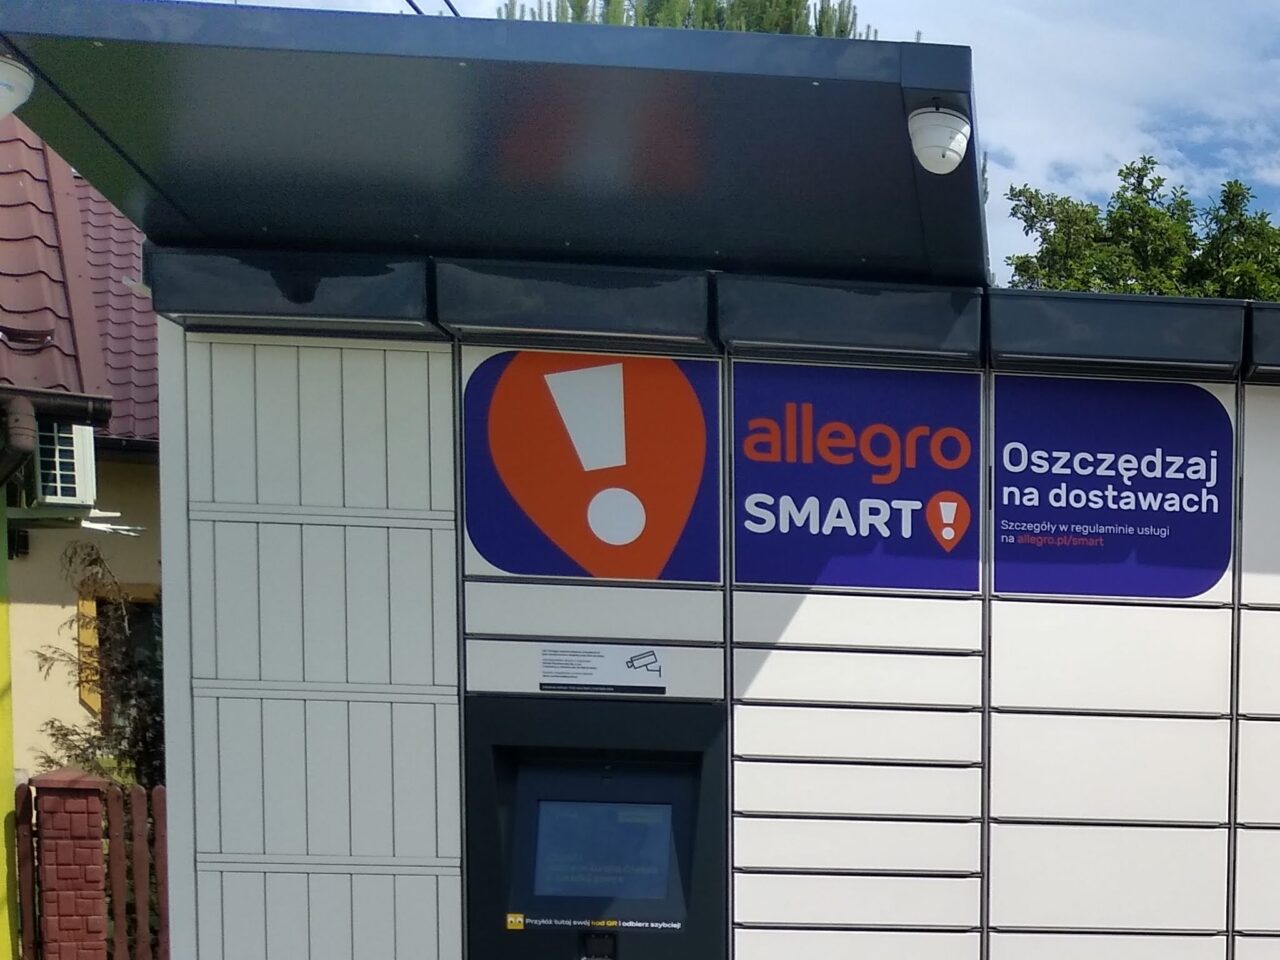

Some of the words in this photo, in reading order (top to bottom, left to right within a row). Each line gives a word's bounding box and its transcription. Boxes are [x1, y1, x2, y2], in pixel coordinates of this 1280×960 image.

[743, 402, 971, 484] allegro
[1002, 441, 1218, 487] Oszczędzaj
[1002, 485, 1040, 506] na
[1048, 482, 1219, 513] dostawach
[1001, 519, 1057, 534] Szczegóły
[1059, 524, 1070, 532] w
[1071, 522, 1135, 535] regulaminie
[1137, 524, 1170, 538] usługi
[1001, 534, 1015, 543] na
[1017, 533, 1104, 547] allegro.pl/smart
